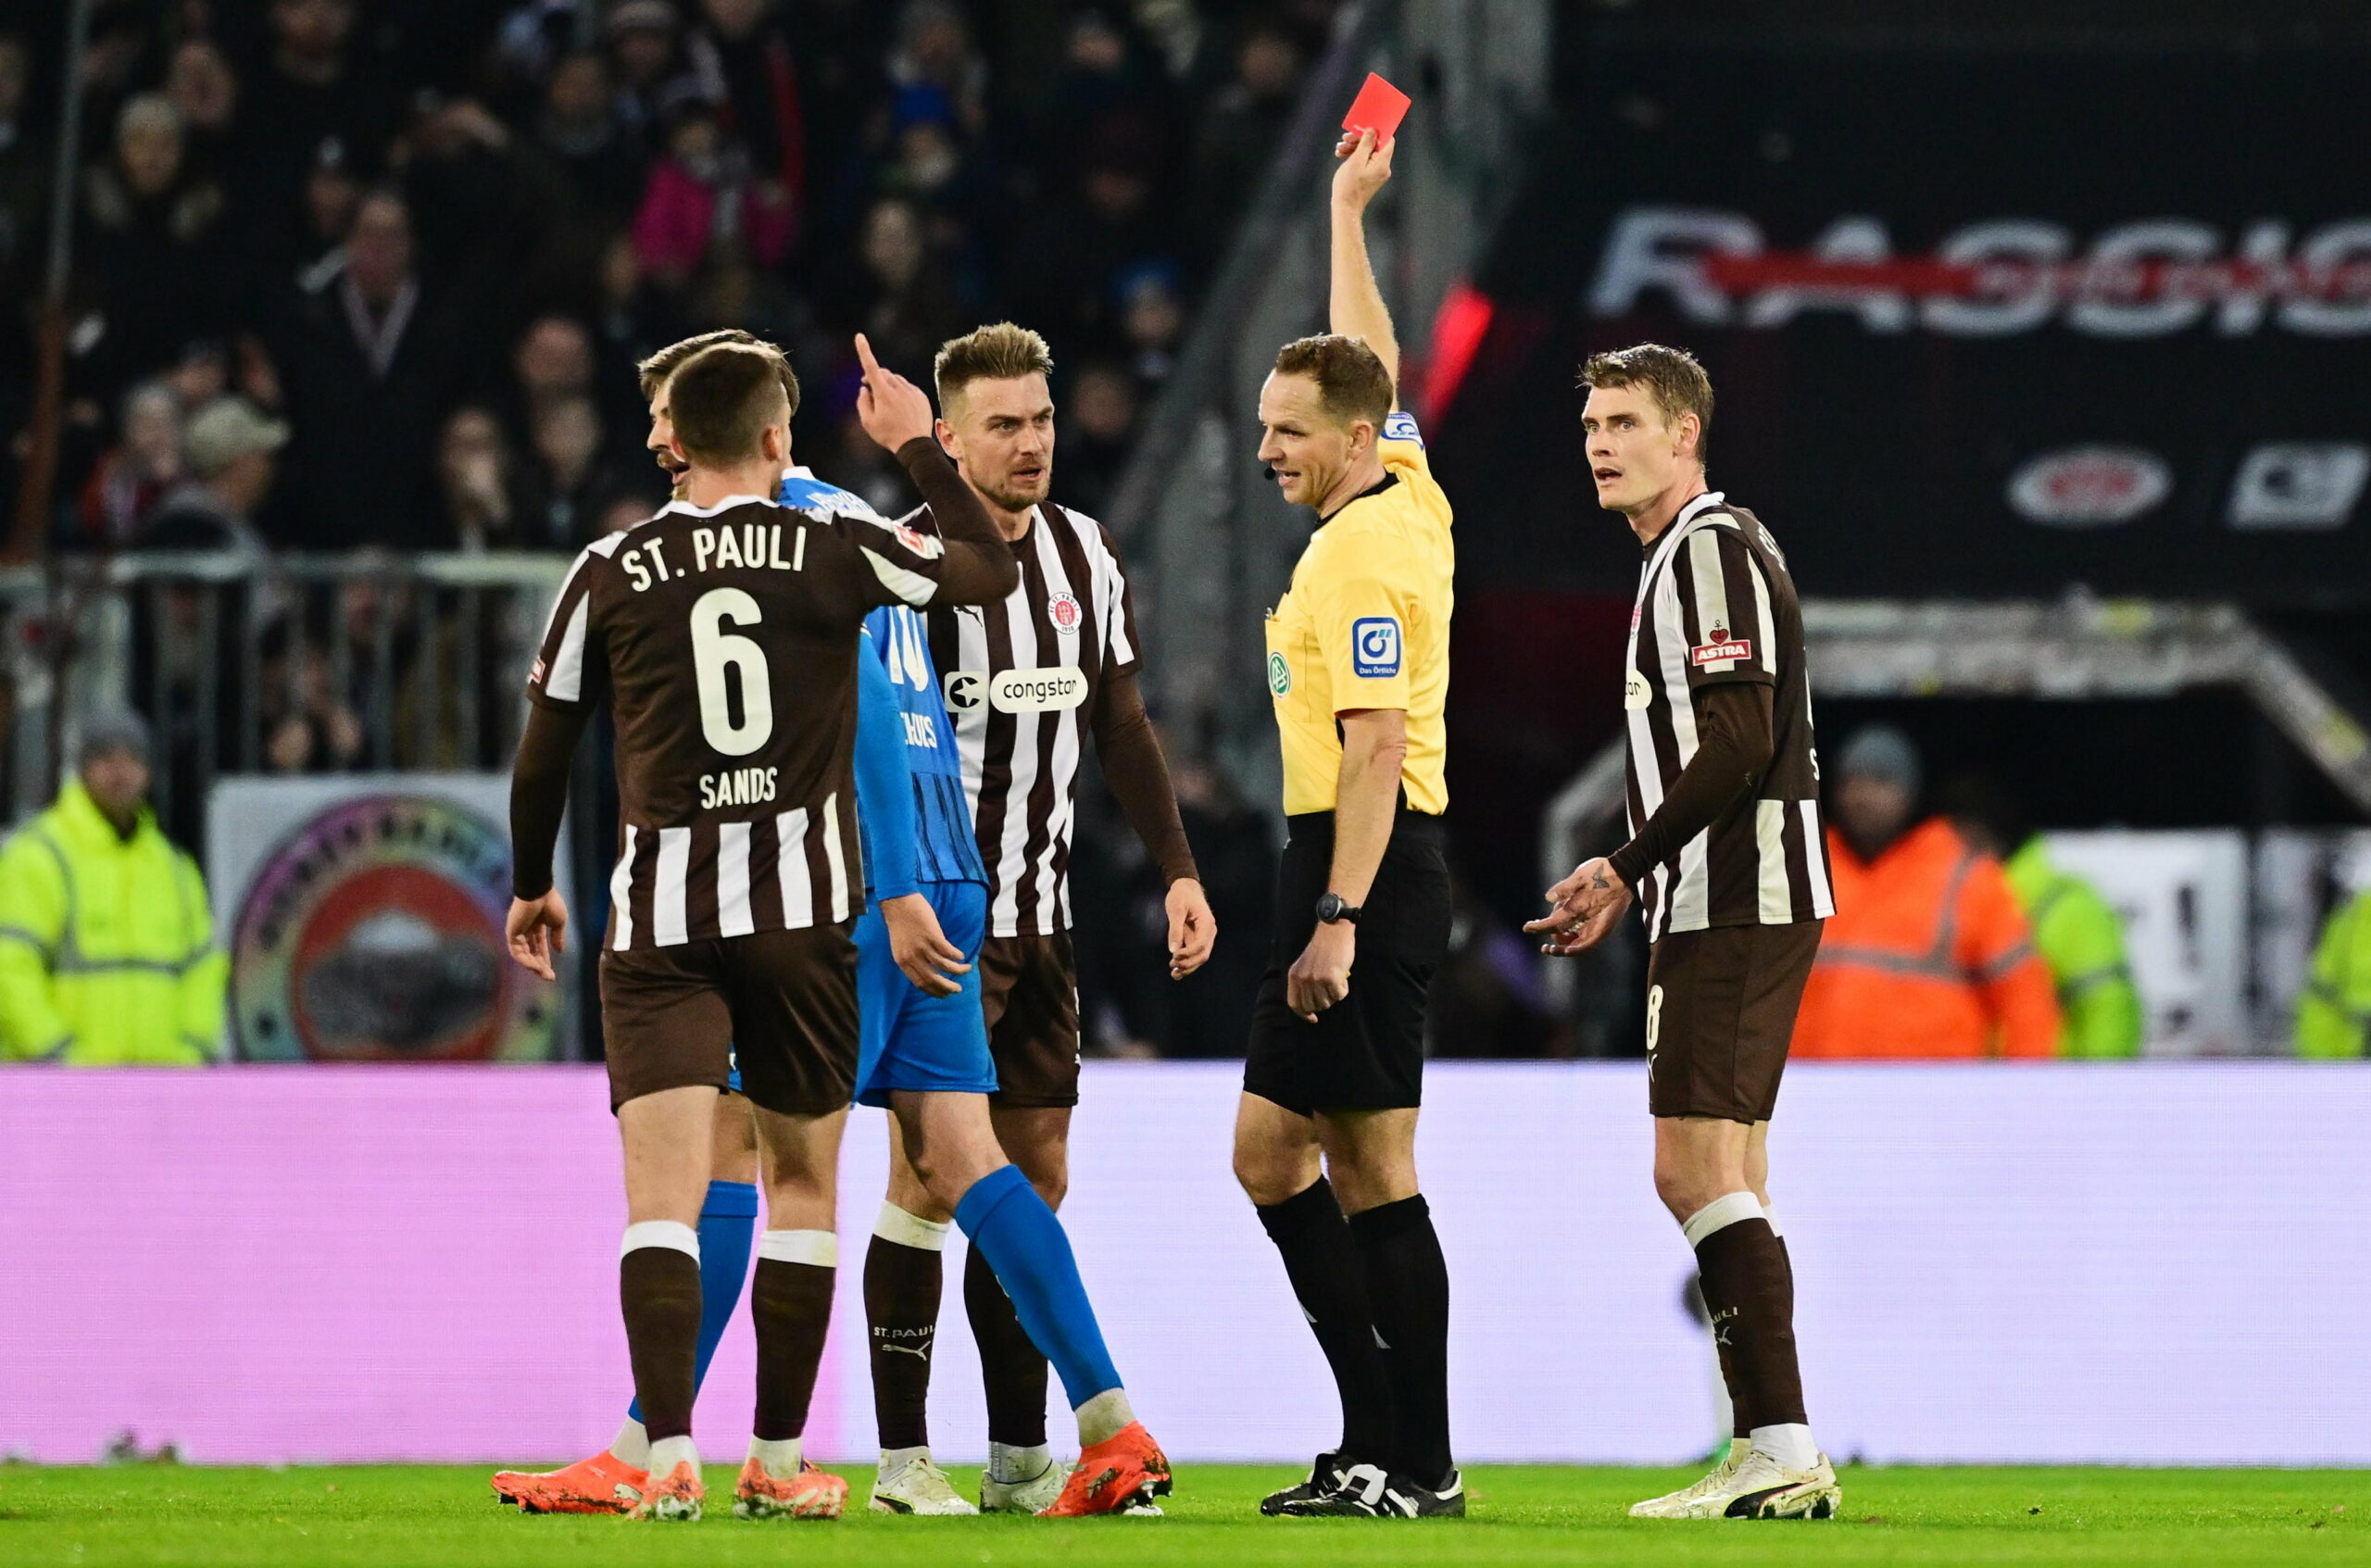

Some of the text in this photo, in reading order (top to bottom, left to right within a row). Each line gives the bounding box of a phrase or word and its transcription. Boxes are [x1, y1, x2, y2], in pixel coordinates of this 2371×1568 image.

[621, 523, 807, 593] ST. PAULI
[689, 587, 773, 757] 6
[1698, 644, 1748, 660] ASTRA
[1003, 676, 1077, 704] congstar
[698, 766, 779, 810] SANDS
[1646, 984, 1664, 1051] 8
